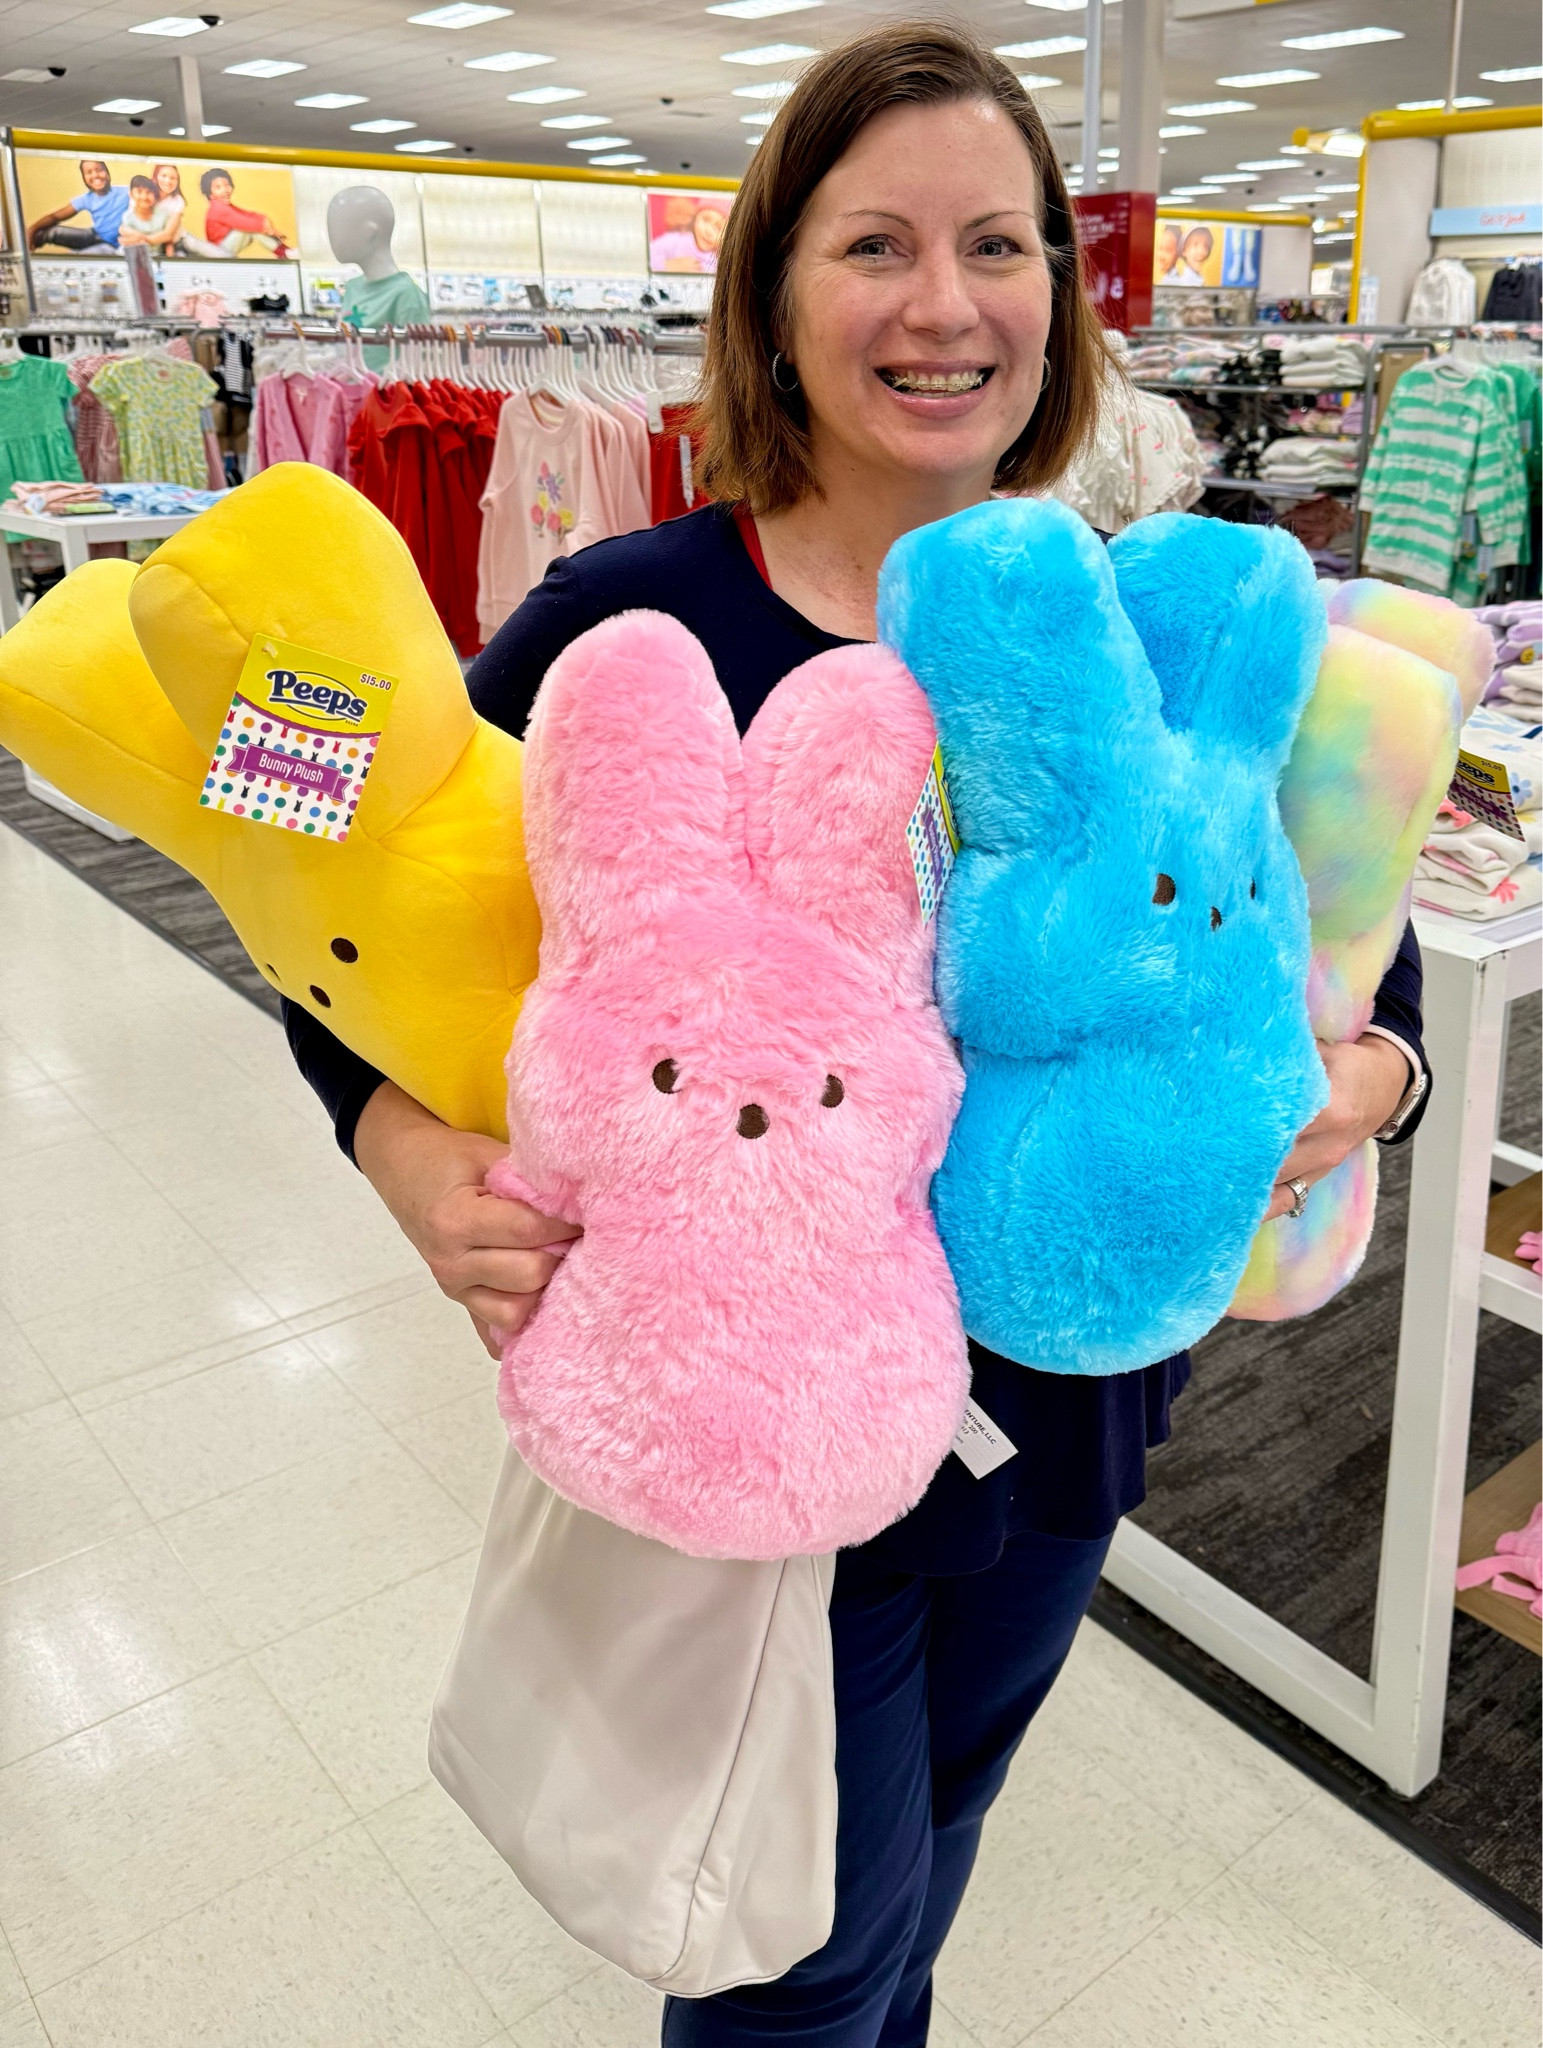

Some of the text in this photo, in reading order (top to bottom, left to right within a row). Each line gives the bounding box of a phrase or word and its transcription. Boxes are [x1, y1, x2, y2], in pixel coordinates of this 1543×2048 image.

[266, 669, 368, 718] Peeps
[360, 673, 392, 691] $15.00
[258, 753, 324, 784] Bunny Plush
[1457, 761, 1495, 783] eeps
[964, 1409, 986, 1434] ENTURE,
[984, 1432, 997, 1445] LLC
